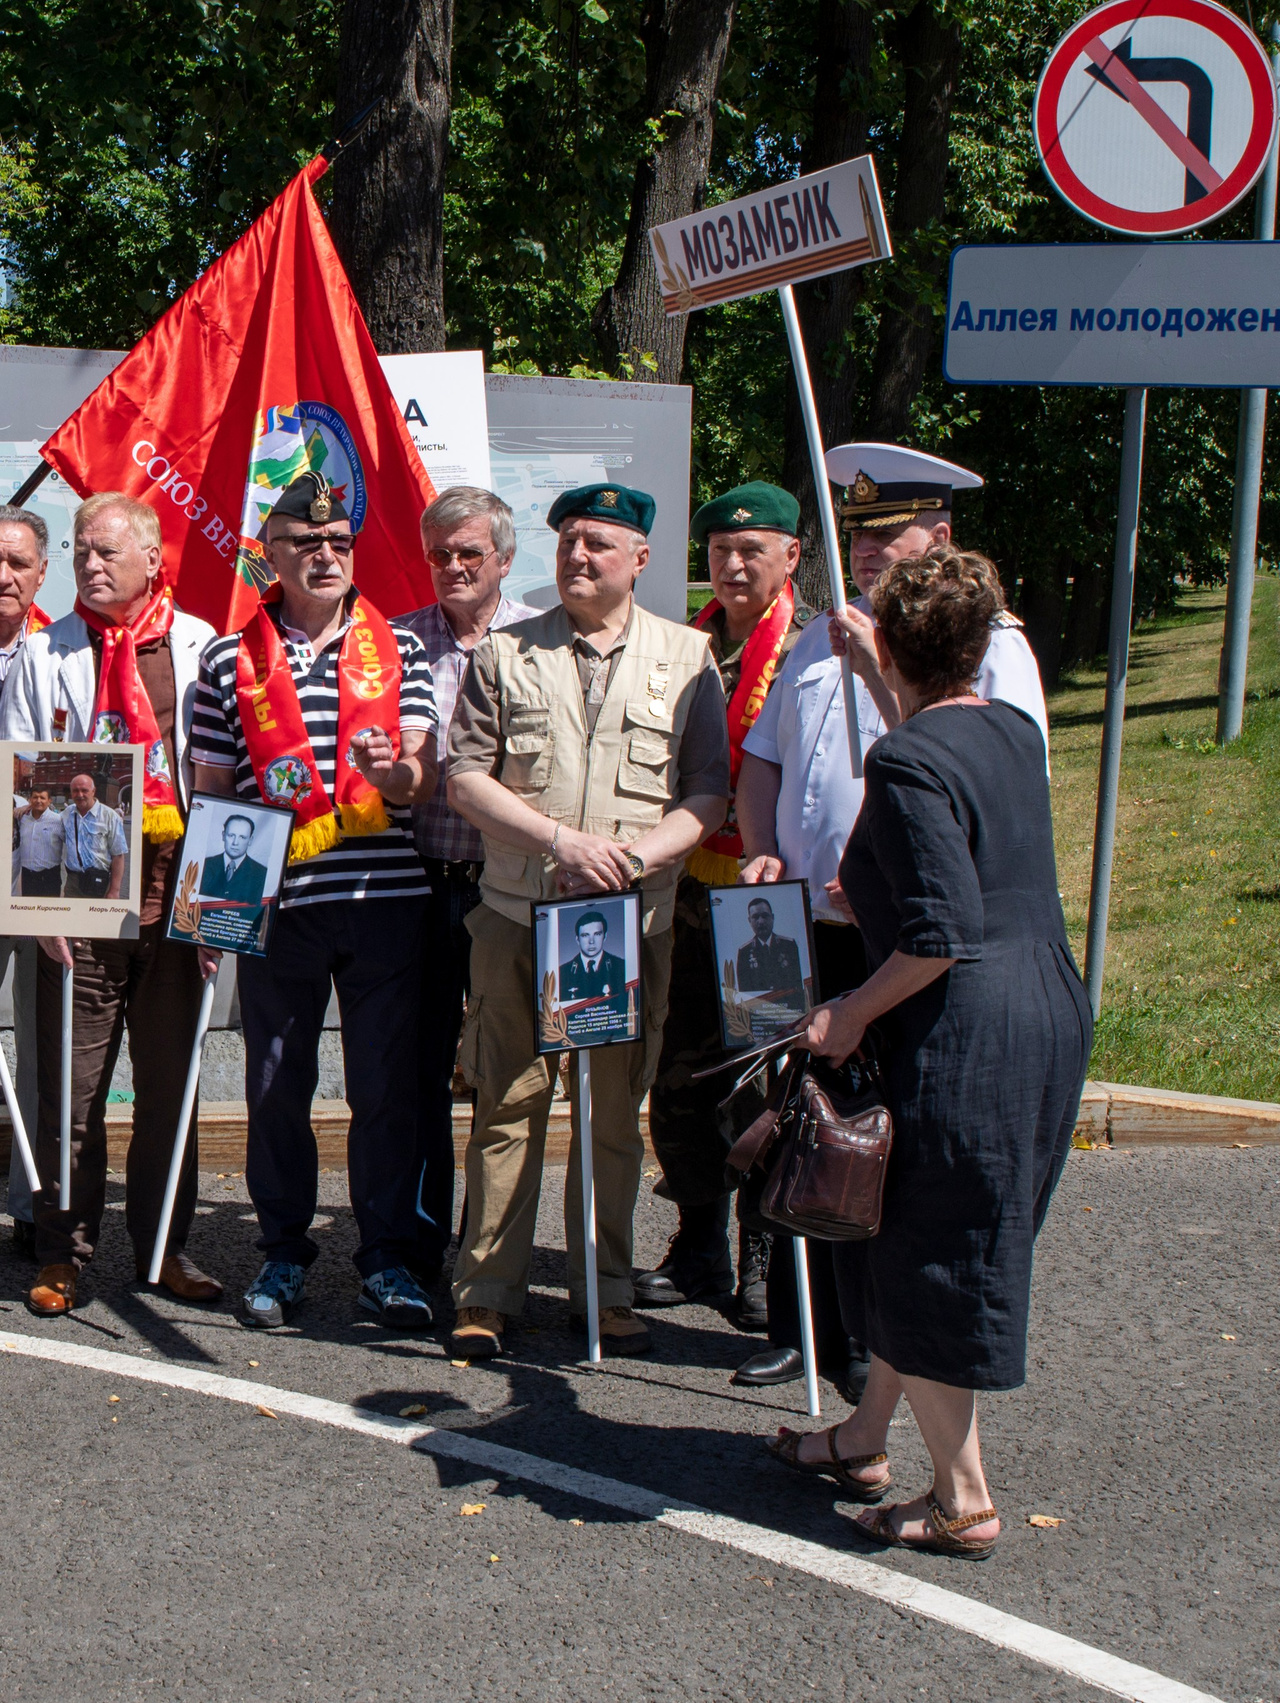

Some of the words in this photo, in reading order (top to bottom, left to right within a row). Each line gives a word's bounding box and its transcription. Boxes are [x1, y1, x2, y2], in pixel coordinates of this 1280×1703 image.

[680, 181, 841, 282] МОЗАМБИК
[951, 300, 1058, 332] Аллея
[1070, 307, 1280, 338] молодожен
[308, 404, 331, 422] СОЮЗ
[329, 416, 359, 471] ВЕТЕРАНОВ
[132, 440, 208, 521] СОЮЗ
[200, 513, 239, 569] ВЕ
[36, 904, 71, 912] Кириченко
